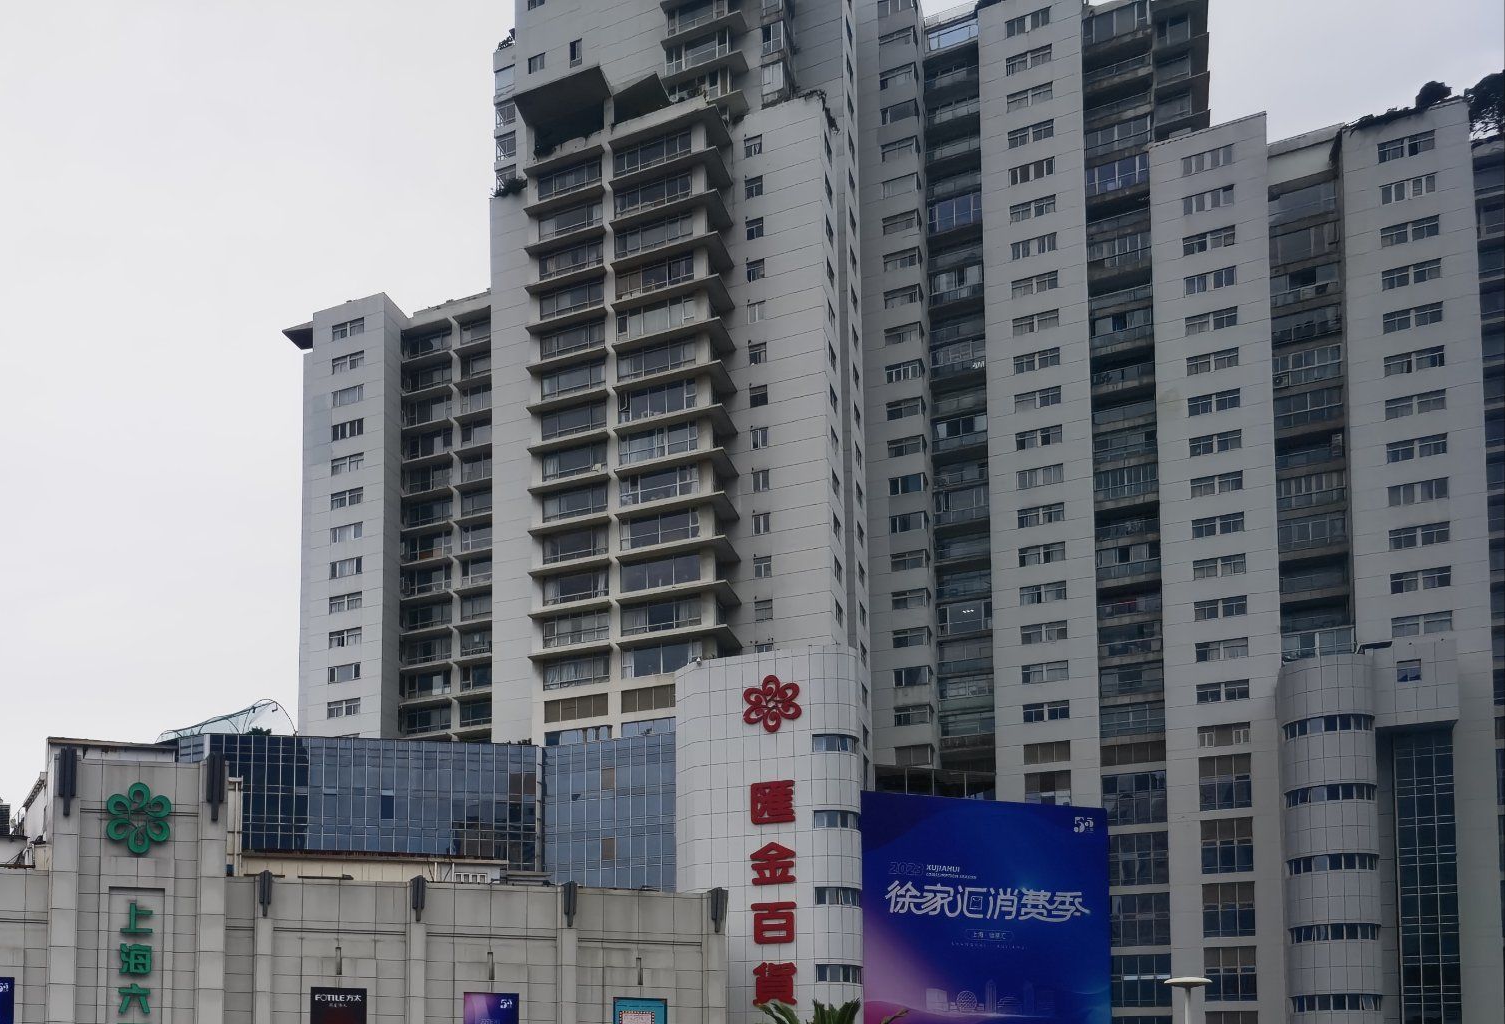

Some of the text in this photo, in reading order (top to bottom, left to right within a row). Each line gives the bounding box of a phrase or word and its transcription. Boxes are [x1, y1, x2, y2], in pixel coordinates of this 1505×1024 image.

[749, 779, 798, 1006] 匯金百貨
[884, 880, 1092, 923] 徐家汇消费季
[315, 994, 345, 1002] FOTILE
